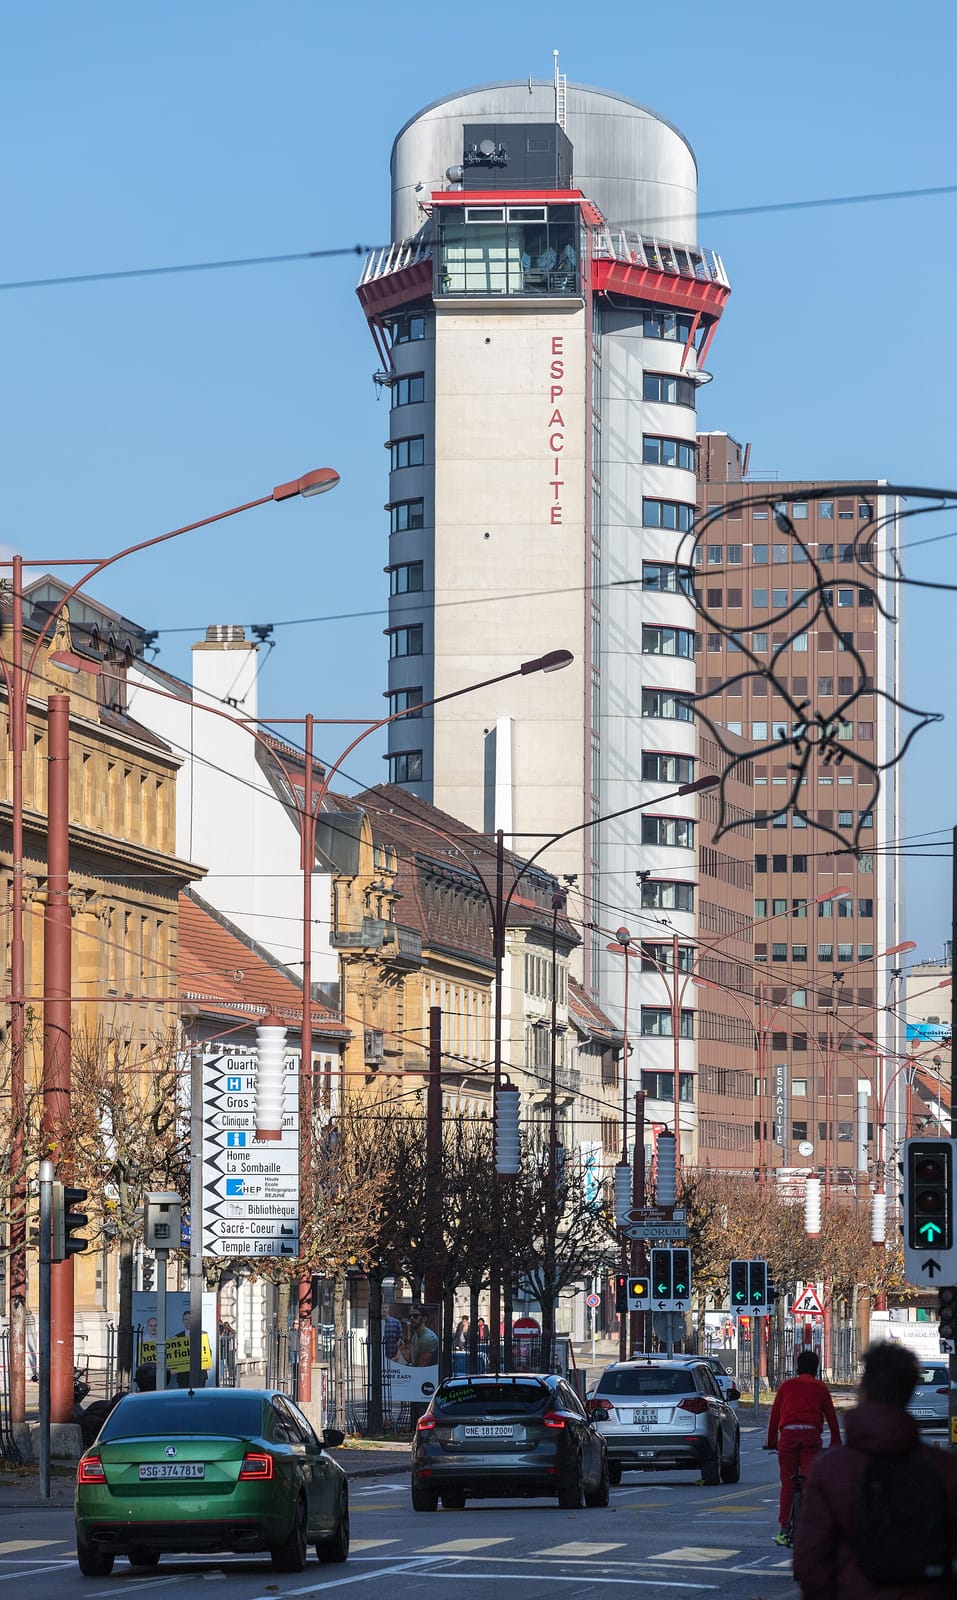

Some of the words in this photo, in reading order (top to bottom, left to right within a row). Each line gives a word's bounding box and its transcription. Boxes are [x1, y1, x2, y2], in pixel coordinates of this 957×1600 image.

[548, 336, 565, 525] ESPACITÉ
[227, 1058, 257, 1071] Quarti
[221, 1115, 249, 1128] Clinique
[226, 1150, 251, 1161] Home
[226, 1162, 237, 1173] La
[241, 1162, 281, 1173] Sombaille
[248, 1204, 295, 1217] Bibliothèque
[220, 1222, 275, 1234] Sacré-Coeur
[643, 1228, 681, 1236] CORUM
[221, 1240, 251, 1254] Temple
[254, 1240, 275, 1253] Farel
[641, 1424, 650, 1433] CH
